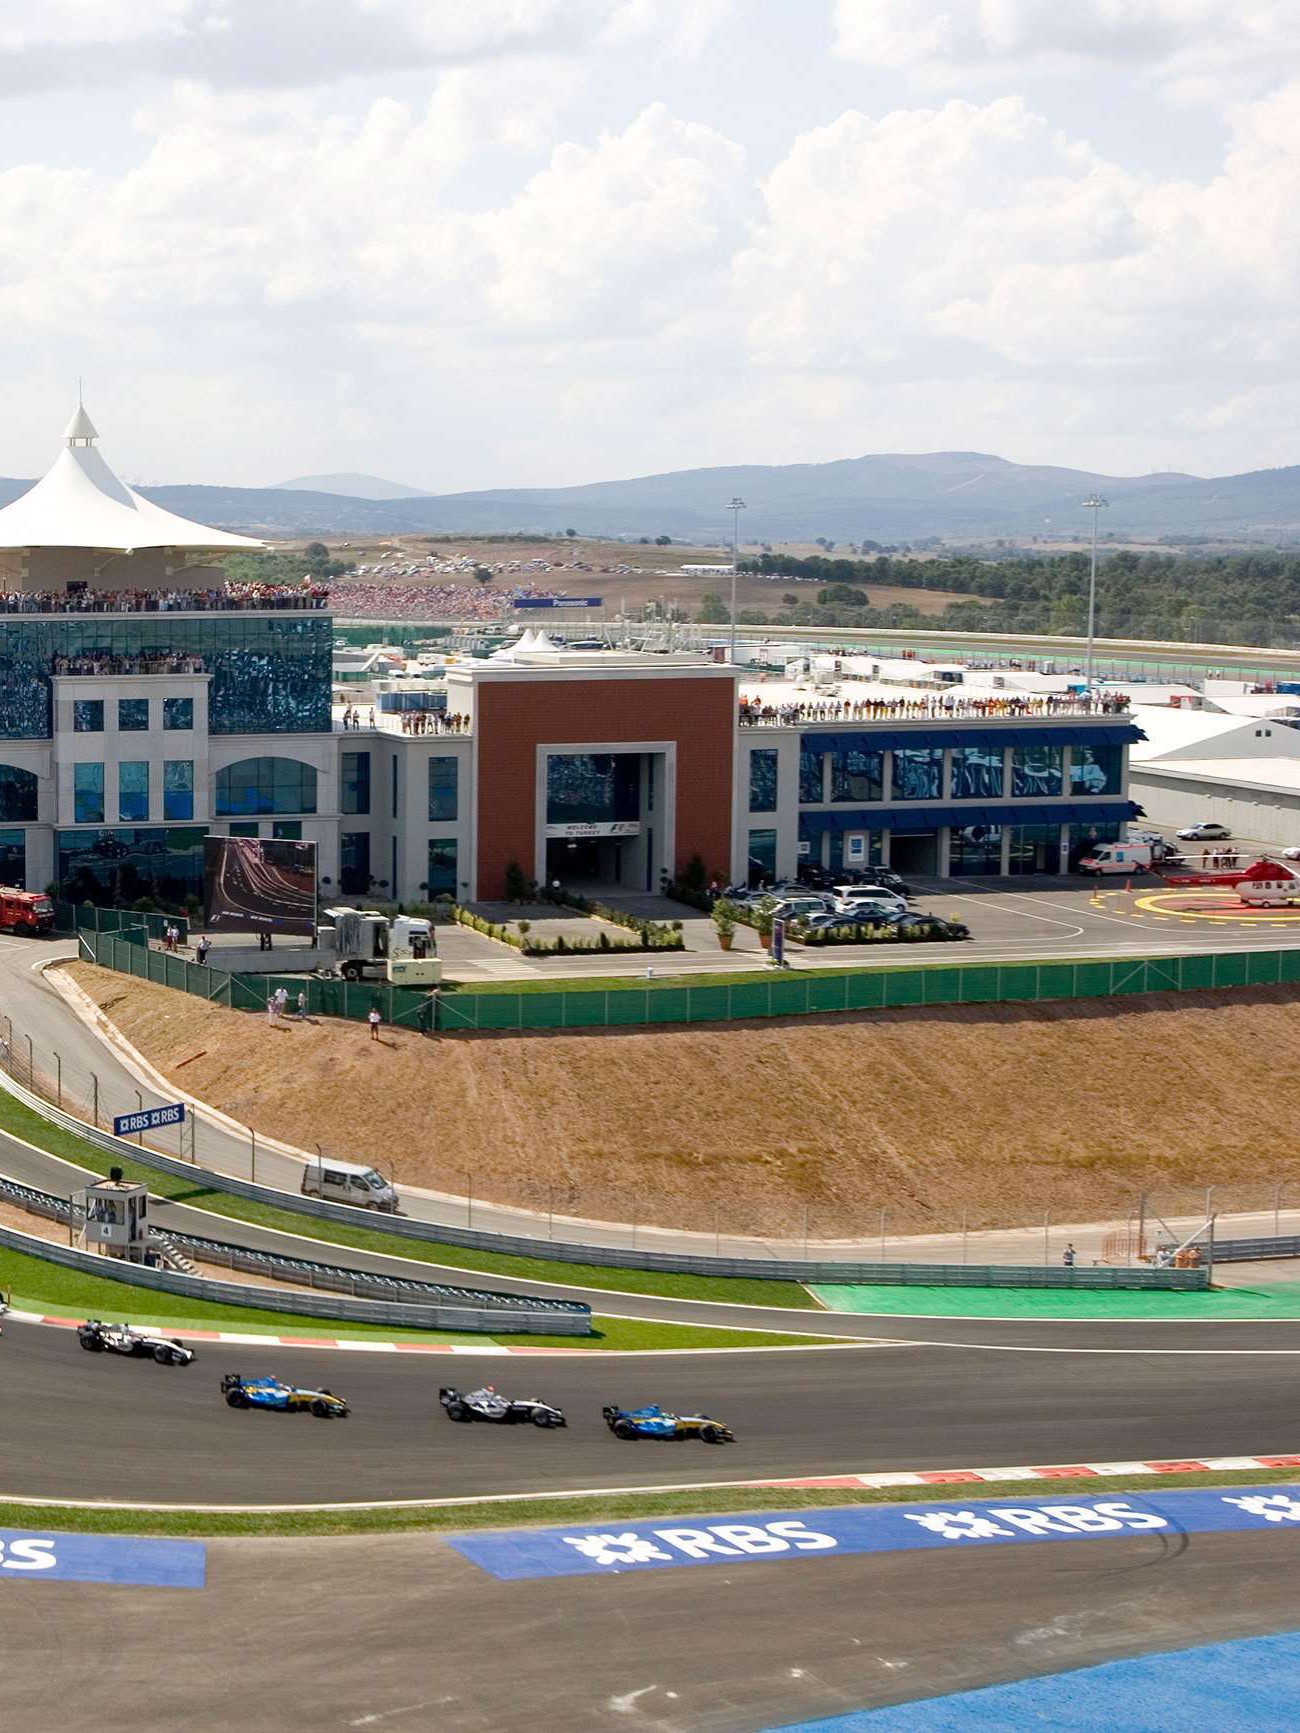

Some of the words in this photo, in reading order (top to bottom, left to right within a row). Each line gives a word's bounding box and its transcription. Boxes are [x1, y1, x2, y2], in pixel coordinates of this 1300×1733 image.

[130, 1114, 149, 1130] RBS
[161, 1107, 180, 1123] RBS
[653, 1521, 838, 1559] RBS
[986, 1502, 1169, 1535] RBS
